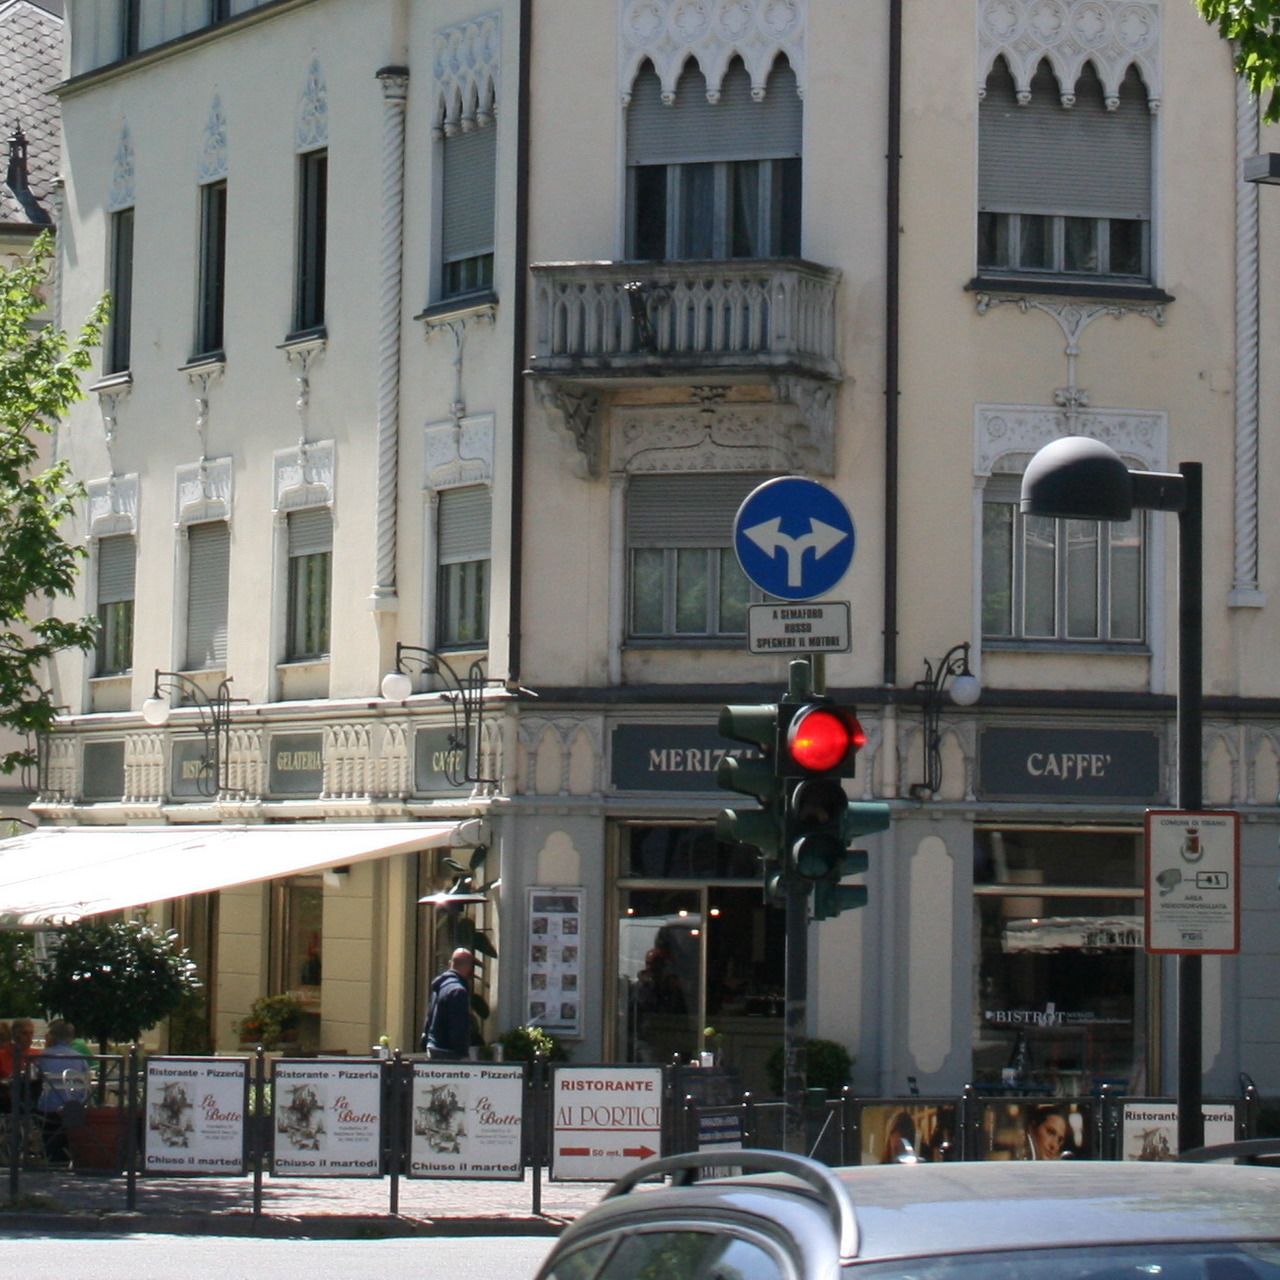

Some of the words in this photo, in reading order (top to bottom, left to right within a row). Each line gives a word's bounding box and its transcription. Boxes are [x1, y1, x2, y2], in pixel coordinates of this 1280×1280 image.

[784, 622, 812, 633] ROSSO
[798, 637, 806, 647] IL
[808, 635, 840, 647] MOTORE
[276, 750, 321, 771] GELATERIA
[1026, 752, 1112, 781] CAFFE'
[148, 1067, 199, 1077] Ristorante
[206, 1068, 244, 1078] Pizzeria
[275, 1070, 329, 1079] Ristorante
[338, 1070, 379, 1079] Pizzeria
[414, 1069, 471, 1079] Ristorante
[480, 1070, 523, 1080] Pizzeria
[560, 1079, 654, 1092] RISTORANTE
[198, 1093, 216, 1110] La
[331, 1095, 350, 1112] La
[470, 1095, 492, 1114] La
[204, 1107, 242, 1122] Botte
[337, 1109, 378, 1124] Botte
[479, 1111, 522, 1126] Botte
[580, 1105, 661, 1127] PORTICI
[1125, 1110, 1179, 1121] Ristorant
[591, 1149, 605, 1157] 50
[147, 1155, 185, 1165] Chiuso
[187, 1156, 195, 1165] il
[275, 1158, 316, 1168] Chiuso
[319, 1159, 327, 1168] il
[411, 1162, 456, 1171] Chiuso
[459, 1162, 468, 1171] il
